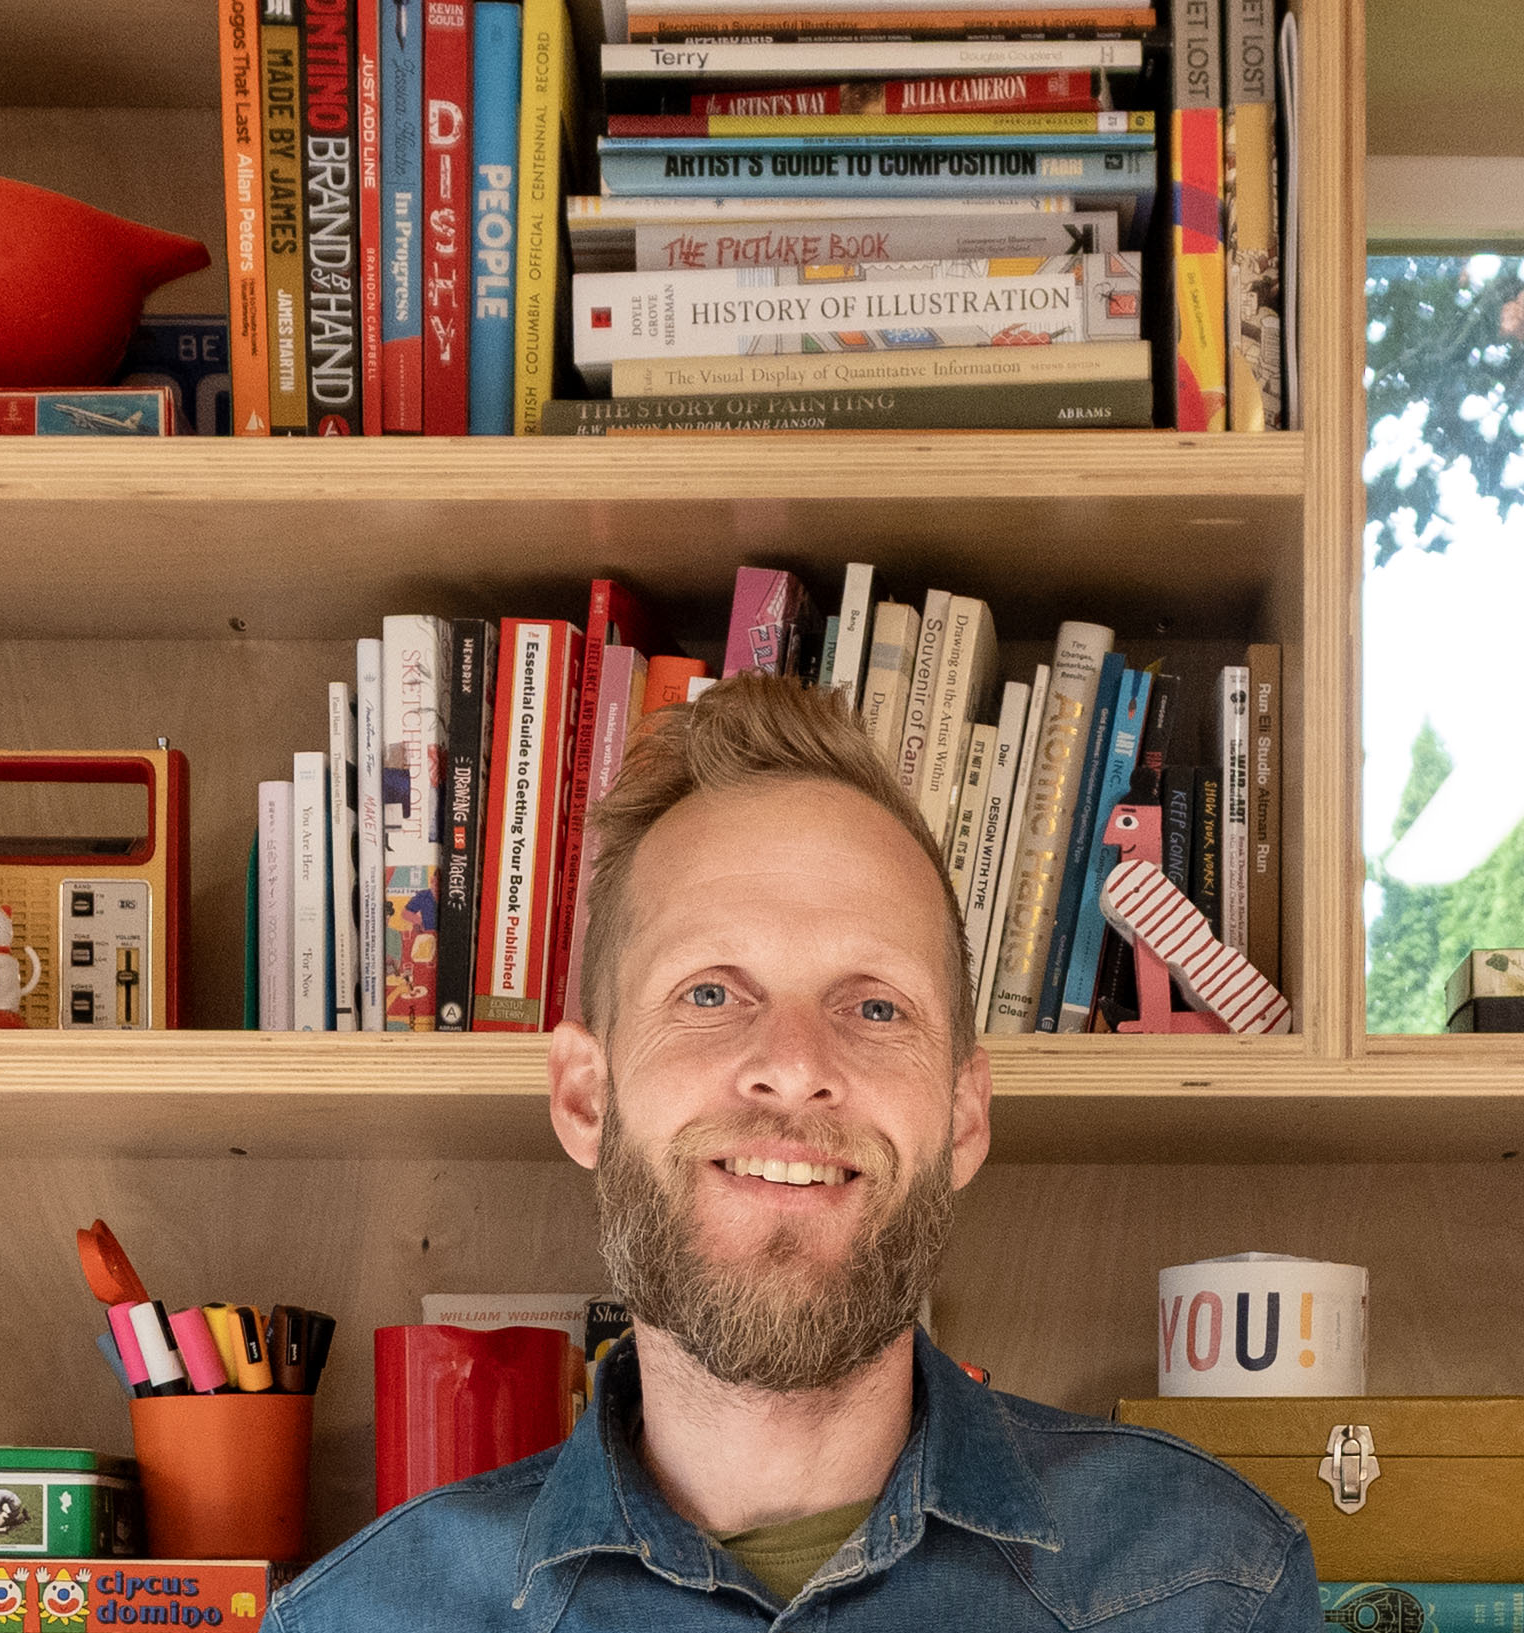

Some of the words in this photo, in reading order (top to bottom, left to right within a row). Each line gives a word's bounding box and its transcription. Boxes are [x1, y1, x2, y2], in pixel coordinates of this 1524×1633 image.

[428, 2, 464, 15] KEVIN
[428, 13, 465, 28] GOULD
[361, 53, 375, 100] JUST
[650, 48, 710, 69] Terry
[266, 48, 294, 123] MADE
[706, 94, 722, 116] the
[727, 94, 792, 116] ARTIST'S
[796, 92, 826, 114] WAY
[901, 77, 948, 108] JULIA
[949, 75, 1028, 103] CAMERON
[362, 102, 375, 142] ADD
[269, 125, 295, 162] BY
[363, 145, 376, 190] LINE
[269, 167, 297, 256] JAMES
[307, 136, 351, 265] BRAND
[394, 192, 412, 220] In
[476, 165, 513, 320] PEOPLE
[662, 233, 708, 268] THE
[716, 231, 822, 266] PICTURE
[829, 232, 891, 262] BOOK
[365, 248, 376, 313] BRANDON
[390, 224, 413, 322] Progress
[276, 289, 293, 337] JAMES
[631, 294, 643, 336] DOYLE
[647, 293, 660, 336] GROVE
[663, 282, 676, 346] SHERMAN
[691, 298, 811, 325] HISTORY
[821, 296, 855, 319] OF
[866, 287, 1071, 317] ILLUSTRATION
[278, 338, 295, 392] MARTIN
[311, 294, 354, 404] HAND
[366, 316, 378, 382] CAMPBELL
[666, 370, 696, 387] The
[700, 367, 744, 385] Visual
[752, 366, 806, 387] Display
[813, 364, 830, 381] of
[834, 361, 927, 383] Quantitative
[933, 358, 1021, 377] Information
[1057, 406, 1112, 420] ABRAMS
[847, 609, 860, 631] Bang
[948, 614, 969, 660] Drawing
[461, 638, 474, 693] HENDRIX
[522, 641, 539, 710] Essential
[948, 664, 958, 678] on
[944, 681, 957, 701] the
[1258, 682, 1272, 713] Run
[520, 712, 534, 757] Guide
[939, 705, 953, 745] Artist
[1258, 716, 1272, 732] Eli
[930, 749, 948, 793] Within
[997, 743, 1011, 768] Dair
[1257, 736, 1272, 785] Studio
[302, 806, 313, 827] You
[511, 778, 530, 834] Getting
[985, 796, 1001, 843] DESIGN
[1172, 789, 1188, 830] KEEP
[1256, 788, 1270, 842] Altman
[302, 830, 313, 852] Are
[509, 836, 526, 872] Your
[980, 843, 993, 877] WITH
[1169, 832, 1186, 882] GOING
[1256, 844, 1270, 873] Run
[302, 855, 313, 881] Here
[507, 874, 523, 913] Book
[973, 877, 987, 910] TYPE
[502, 914, 520, 991] Published
[997, 987, 1033, 1005] James
[998, 1003, 1029, 1019] Clear
[95, 1600, 224, 1628] domino
